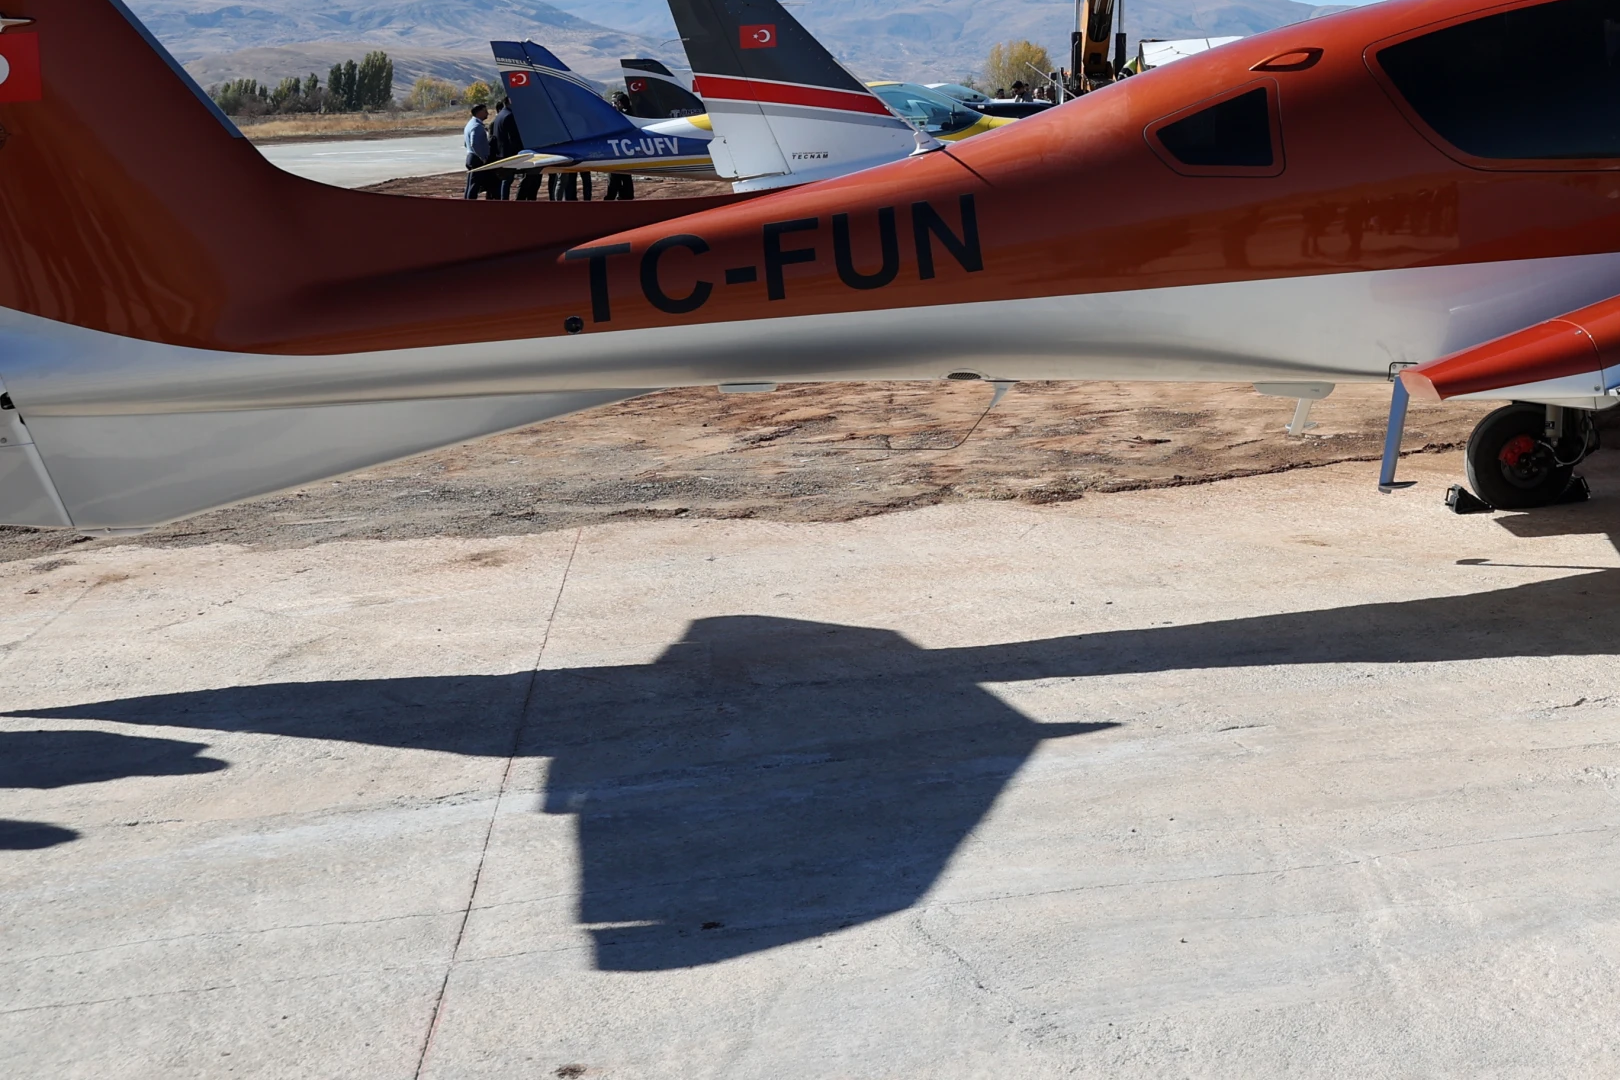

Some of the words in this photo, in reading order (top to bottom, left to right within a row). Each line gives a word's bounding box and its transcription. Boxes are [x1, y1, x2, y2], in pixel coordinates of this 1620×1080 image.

[495, 56, 529, 66] BRISTELL
[607, 137, 679, 157] TC-UFV
[565, 193, 984, 324] TC-FUN
